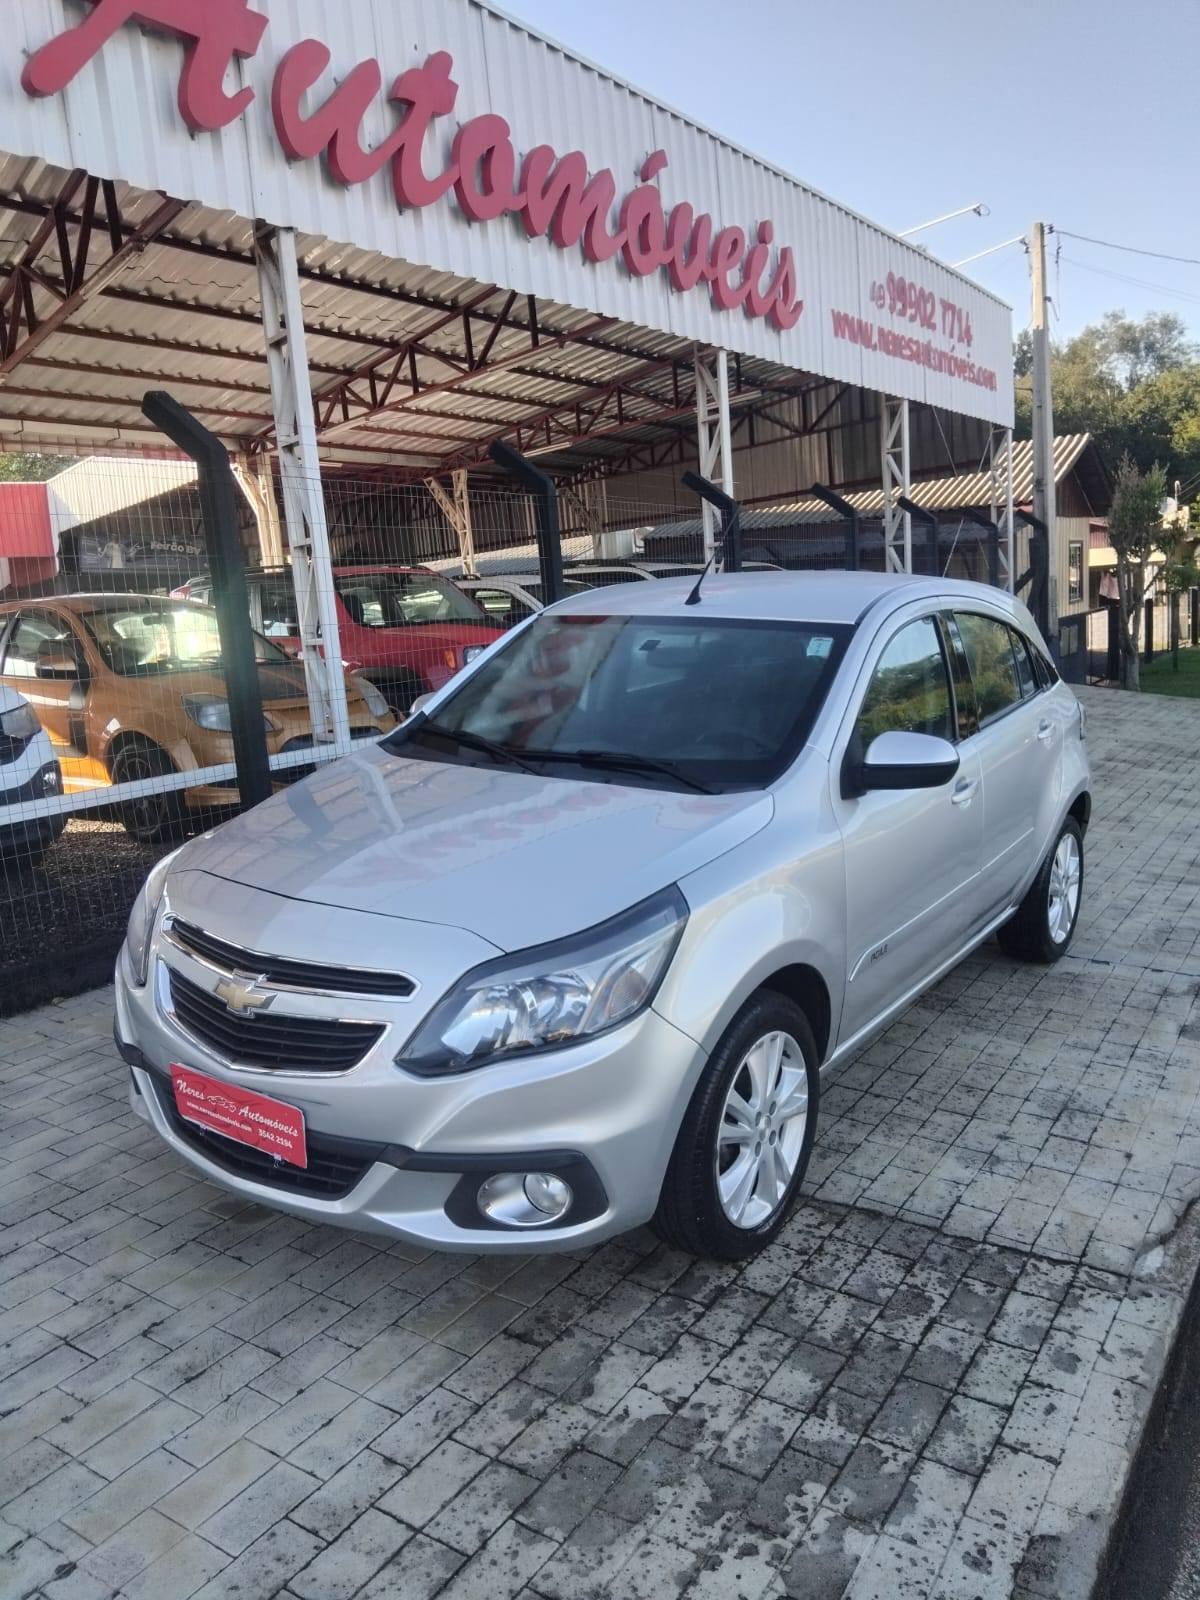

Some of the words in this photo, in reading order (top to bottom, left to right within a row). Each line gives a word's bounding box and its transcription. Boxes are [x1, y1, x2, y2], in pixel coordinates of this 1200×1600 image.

[22, 0, 803, 330] Automóveis
[176, 1079, 204, 1100] Neres
[238, 1106, 299, 1137] Automóveis
